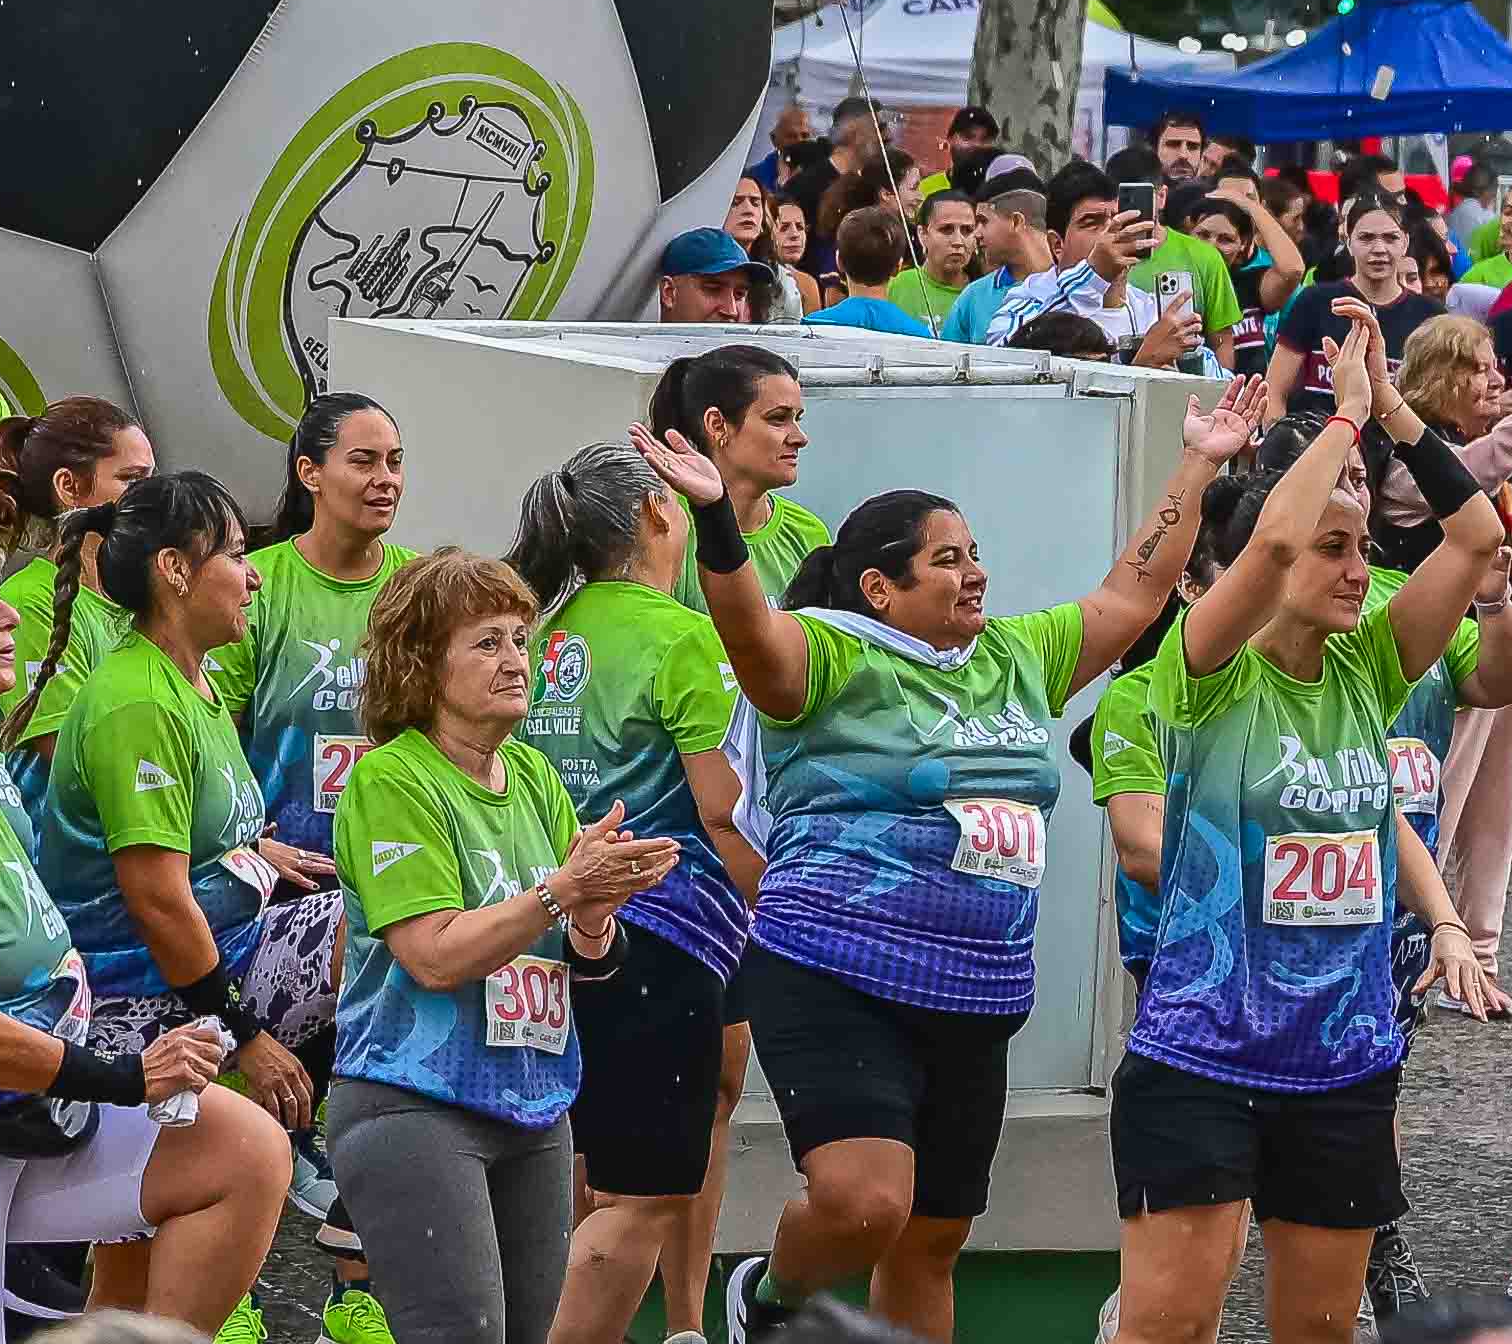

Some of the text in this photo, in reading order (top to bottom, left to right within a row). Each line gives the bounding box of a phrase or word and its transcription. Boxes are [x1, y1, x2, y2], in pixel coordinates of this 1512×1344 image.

[476, 123, 523, 162] MCMVIII
[553, 717, 582, 735] VILLE
[962, 803, 1036, 864] 301
[1272, 841, 1378, 902] 204
[494, 964, 566, 1029] 303
